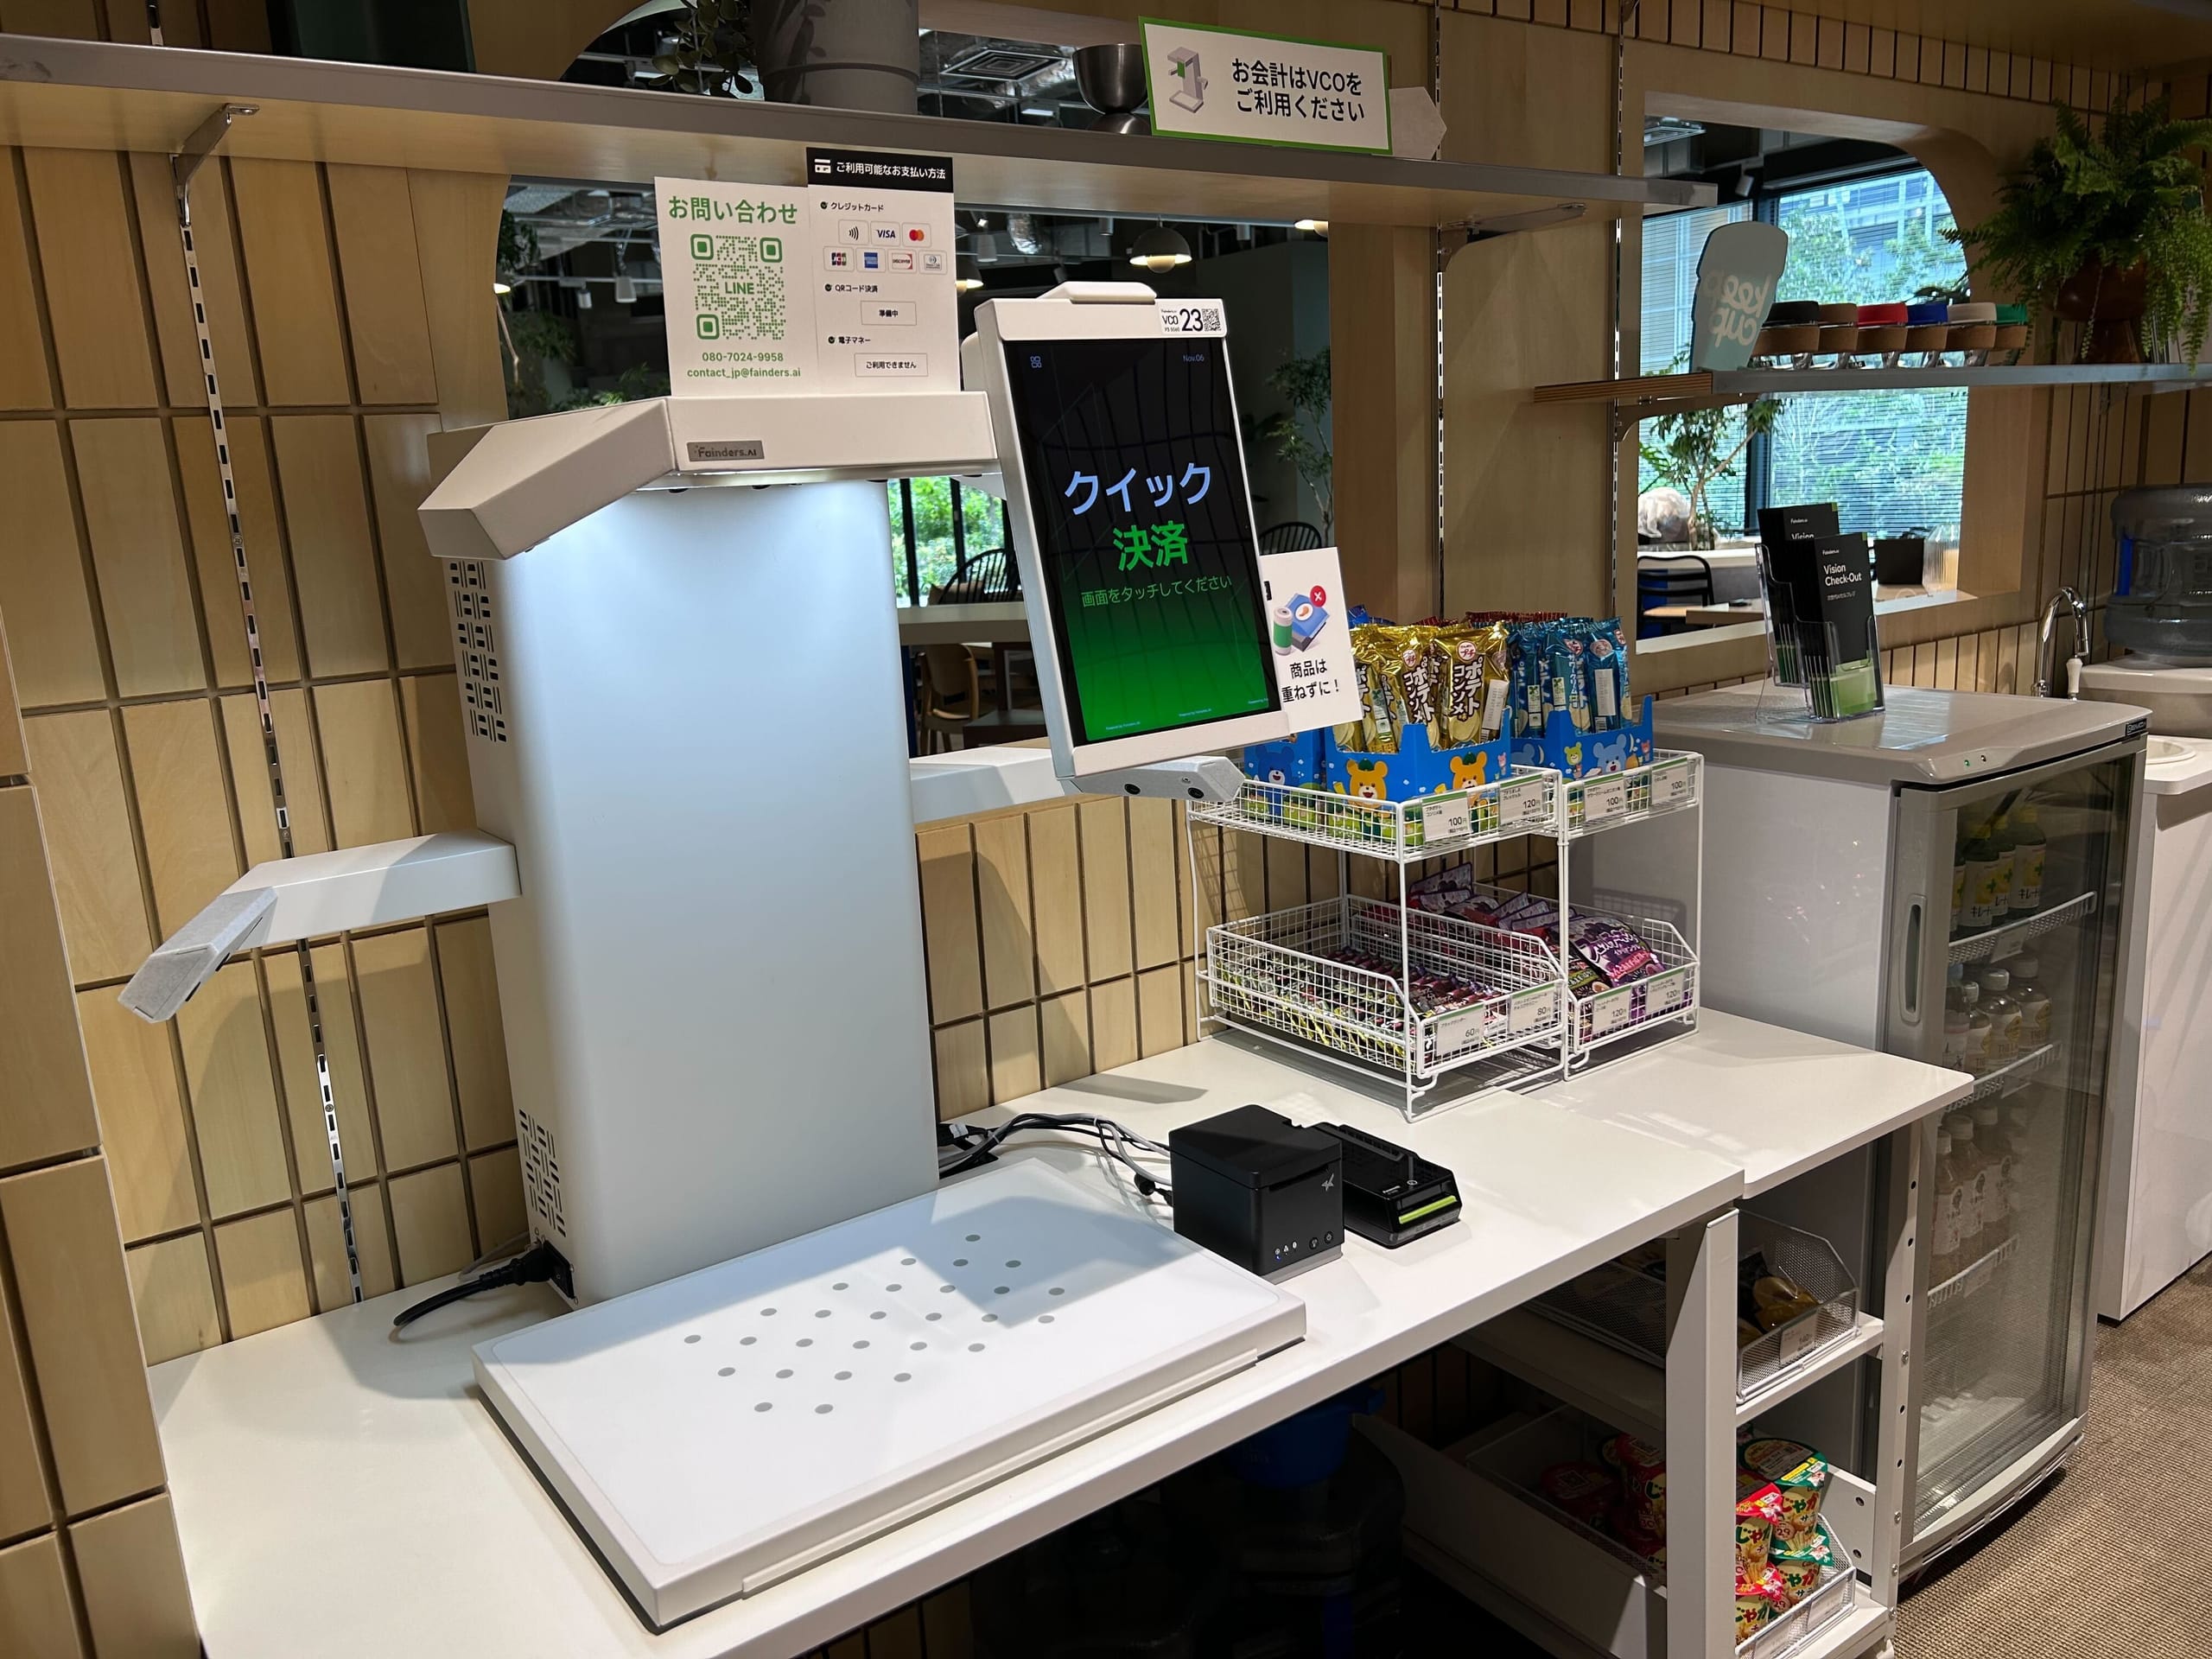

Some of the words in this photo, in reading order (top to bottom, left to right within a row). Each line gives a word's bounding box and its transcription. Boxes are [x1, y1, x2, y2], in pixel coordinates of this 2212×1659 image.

[1231, 58, 1363, 96] お会計はVCOを
[1236, 89, 1364, 122] ご利用ください
[836, 162, 946, 180] ご利用可能なお支払い方法
[668, 196, 798, 225] お問い合わせ
[830, 202, 884, 212] クレジットカード
[876, 229, 896, 238] VISA
[724, 282, 754, 296] LINE
[835, 283, 879, 293] QRコード決済
[1161, 315, 1179, 325] VCO
[1179, 308, 1204, 332] 23
[838, 336, 871, 345] 電子マネー
[702, 352, 784, 362] 080-7024-9958
[687, 367, 801, 378] contact_jp@fainders.ai
[1064, 462, 1211, 516] クイック
[1112, 520, 1189, 572] 決済
[1823, 563, 1847, 575] Vision
[1825, 572, 1862, 586] Check-Out
[1081, 575, 1233, 607] 画面をタッチしてください
[1289, 659, 1327, 679] 商品は
[1465, 657, 1484, 715] ポテト
